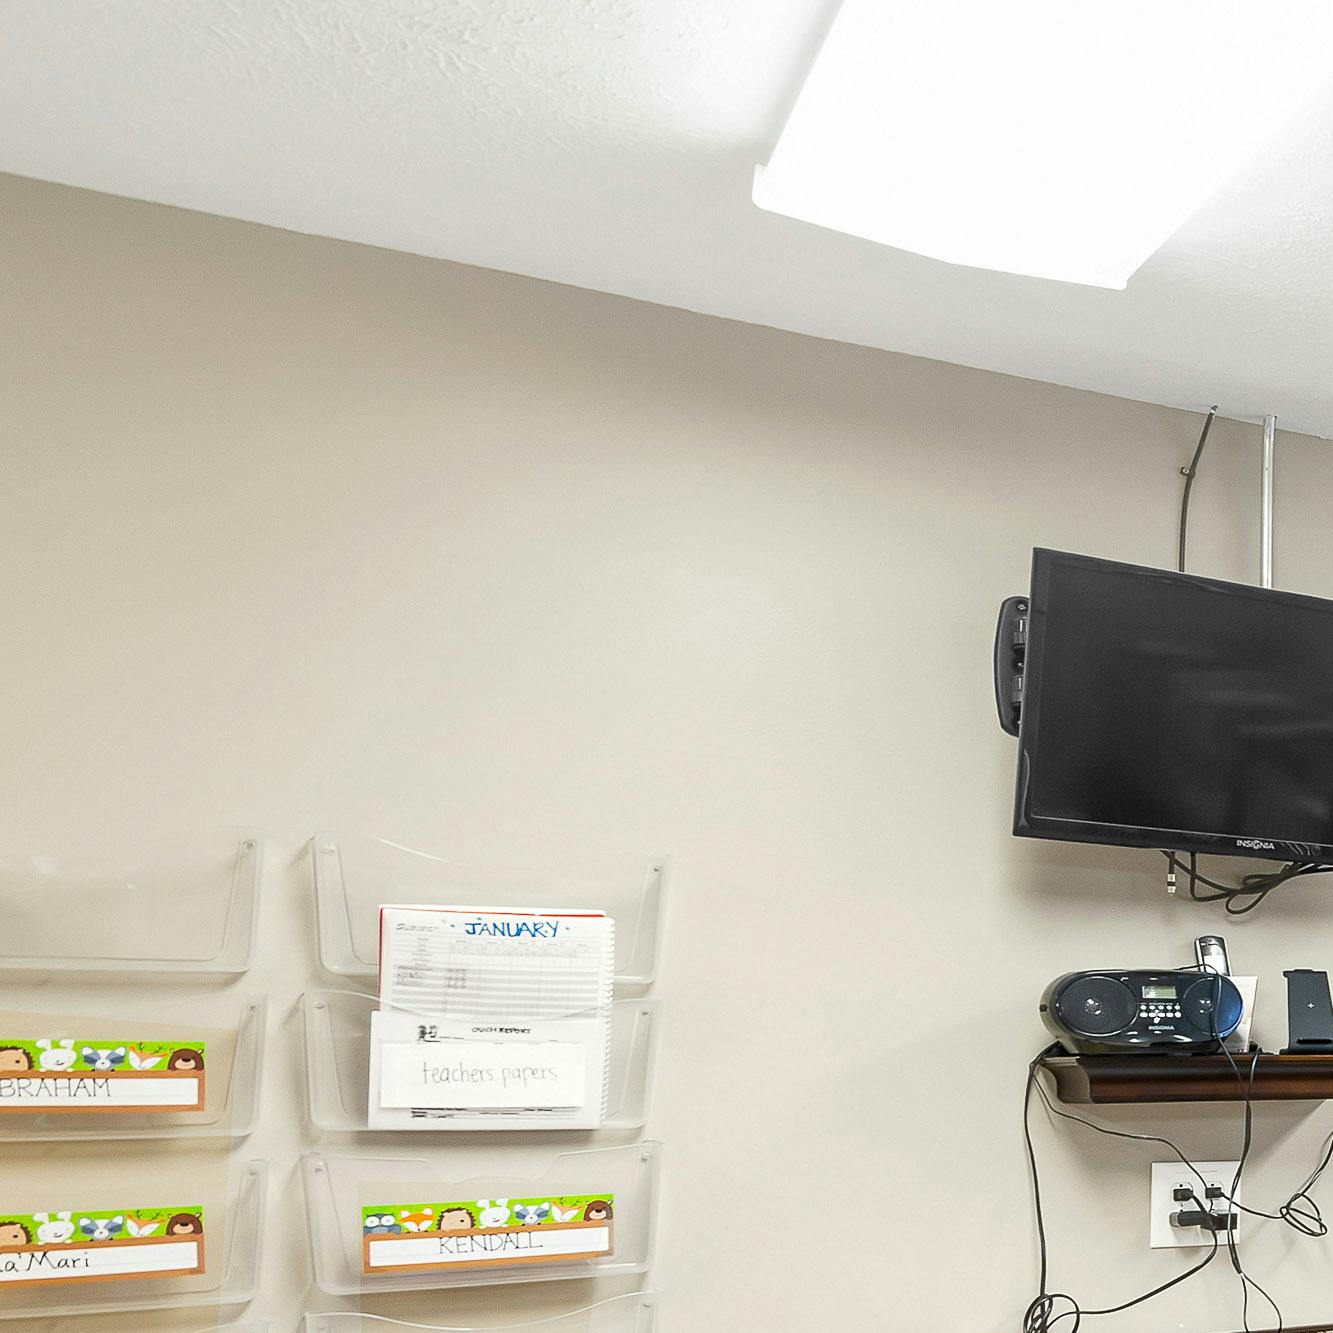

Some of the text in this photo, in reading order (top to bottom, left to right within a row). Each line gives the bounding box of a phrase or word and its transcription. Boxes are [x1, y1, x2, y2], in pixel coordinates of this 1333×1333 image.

[1236, 840, 1275, 850] INSIGNIA
[464, 920, 560, 938] JANUARY
[422, 1061, 559, 1088] teachers papers
[437, 1231, 544, 1255] KENDALL
